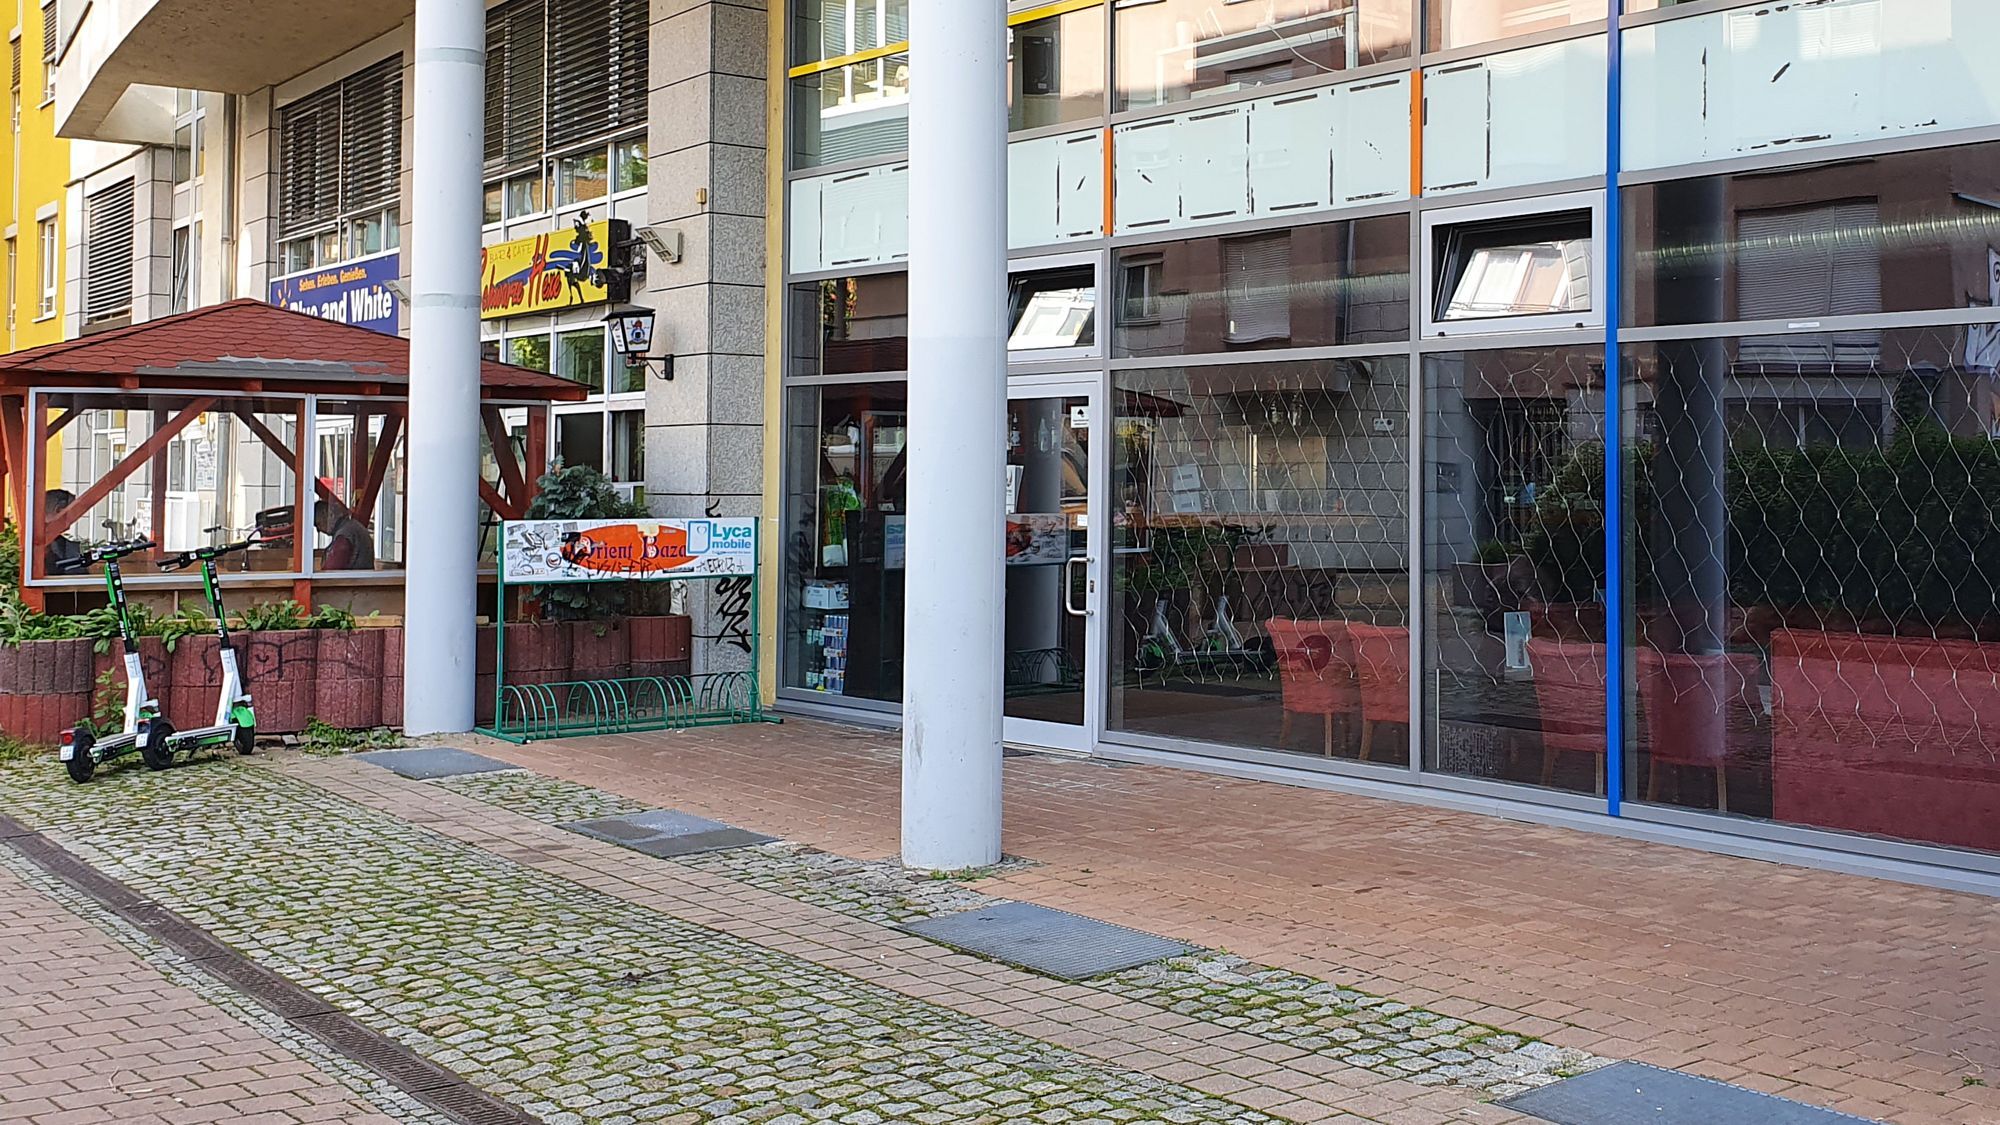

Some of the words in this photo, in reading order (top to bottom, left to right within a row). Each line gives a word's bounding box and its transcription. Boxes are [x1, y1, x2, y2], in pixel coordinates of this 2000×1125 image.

[527, 233, 562, 308] Hexe
[321, 291, 347, 324] and
[350, 285, 393, 323] White
[712, 523, 752, 540] Lyca
[712, 539, 751, 549] mobile
